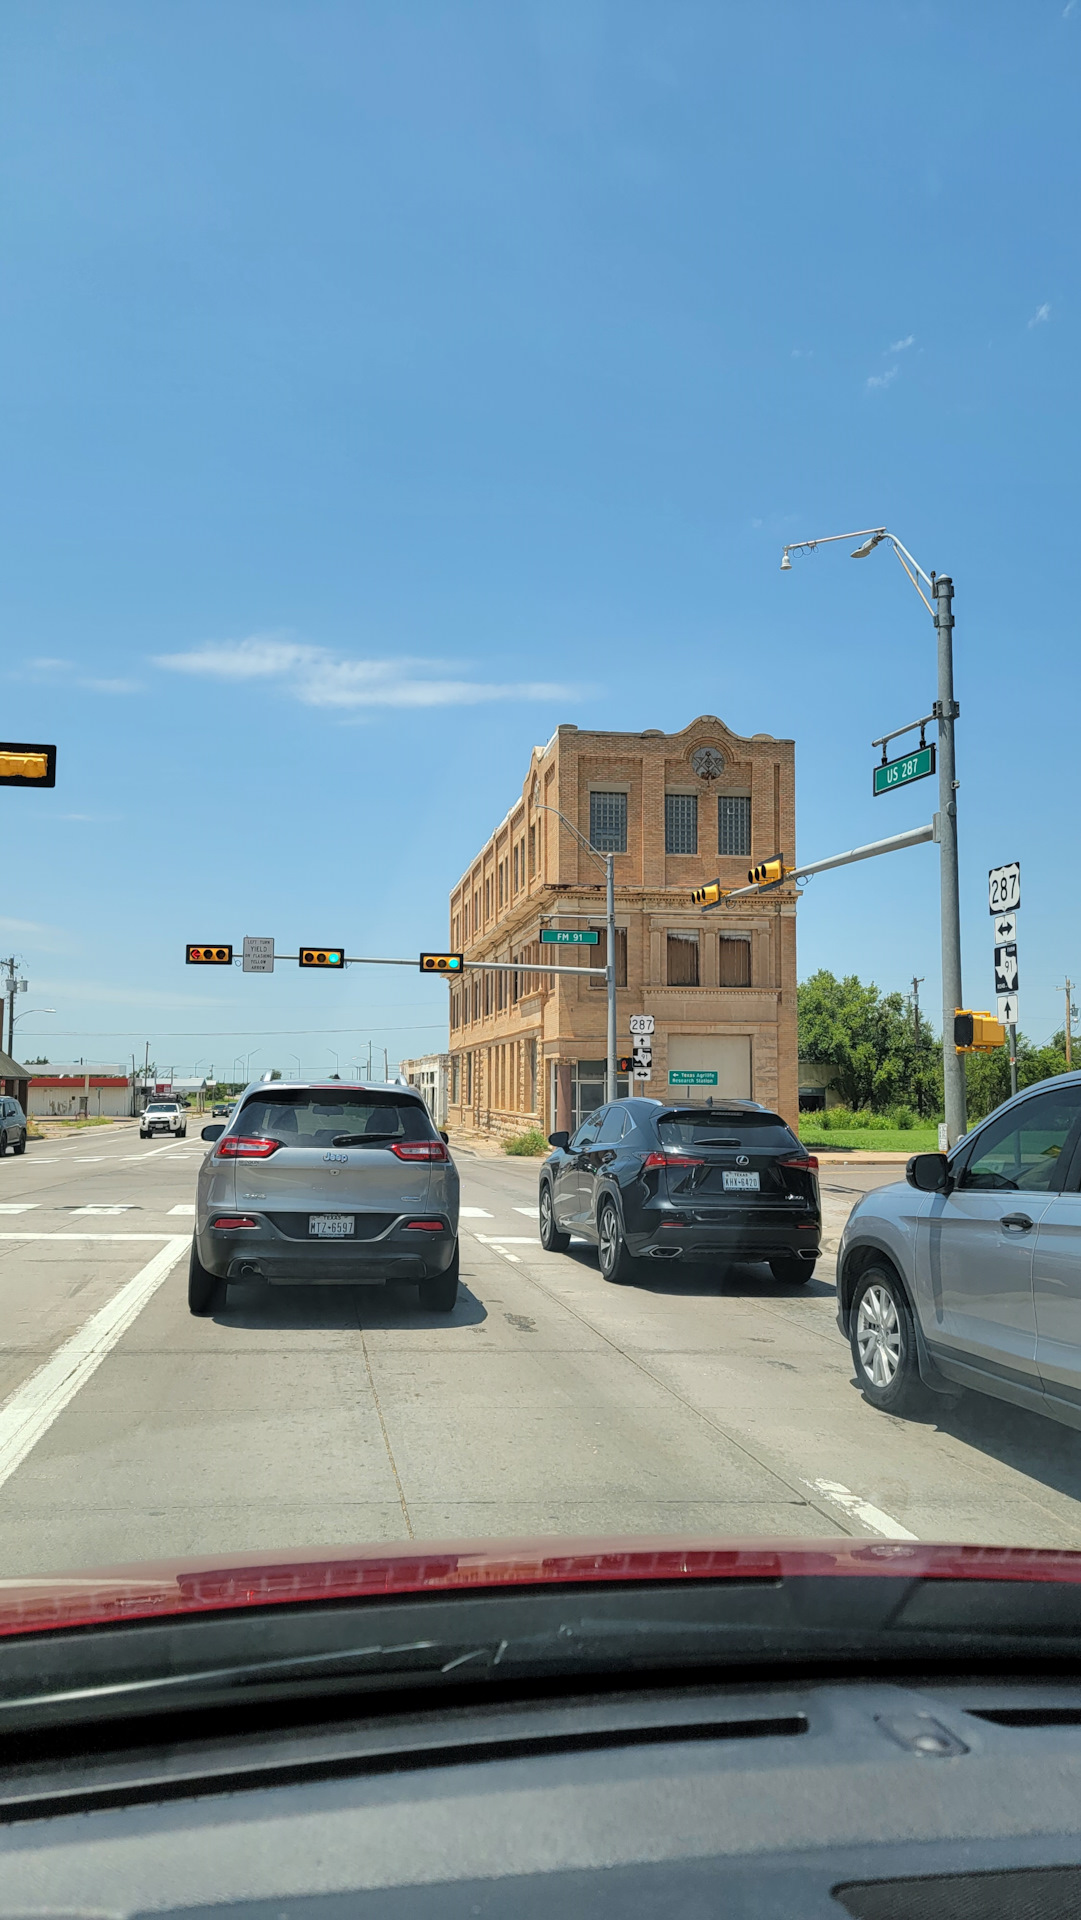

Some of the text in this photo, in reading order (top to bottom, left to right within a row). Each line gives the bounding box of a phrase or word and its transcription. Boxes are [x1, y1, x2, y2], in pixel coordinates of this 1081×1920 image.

[887, 758, 918, 784] US 287
[992, 874, 1017, 904] 287
[557, 933, 583, 942] FM 91
[1005, 960, 1012, 972] 91
[632, 1019, 653, 1030] 287
[323, 1152, 348, 1162] Jeep
